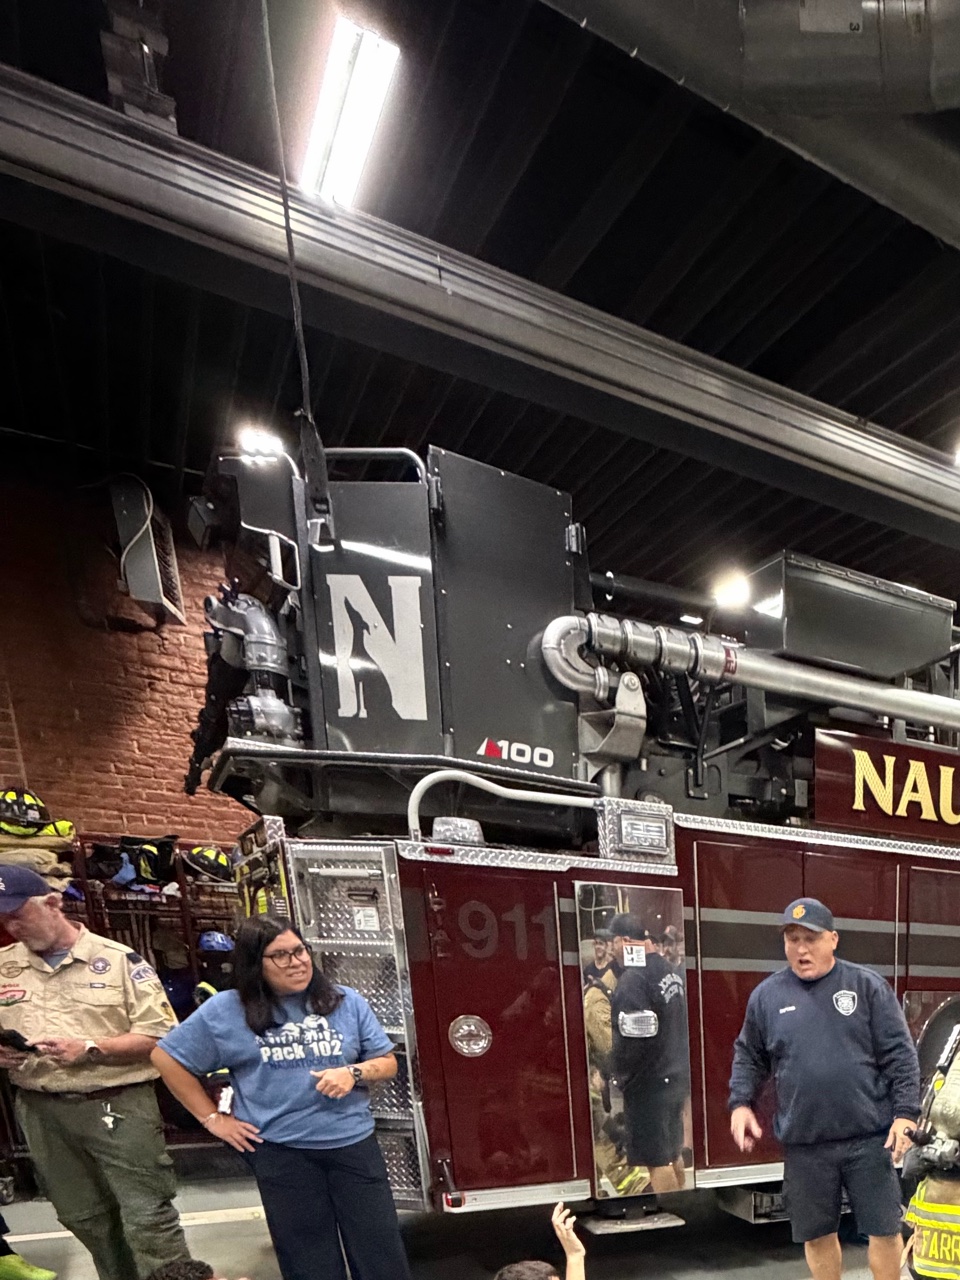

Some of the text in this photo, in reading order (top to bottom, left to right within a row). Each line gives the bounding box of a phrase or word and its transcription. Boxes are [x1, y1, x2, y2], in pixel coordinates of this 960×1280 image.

[326, 574, 428, 720] N
[458, 900, 558, 962] 911
[260, 1040, 343, 1062] Pack 102
